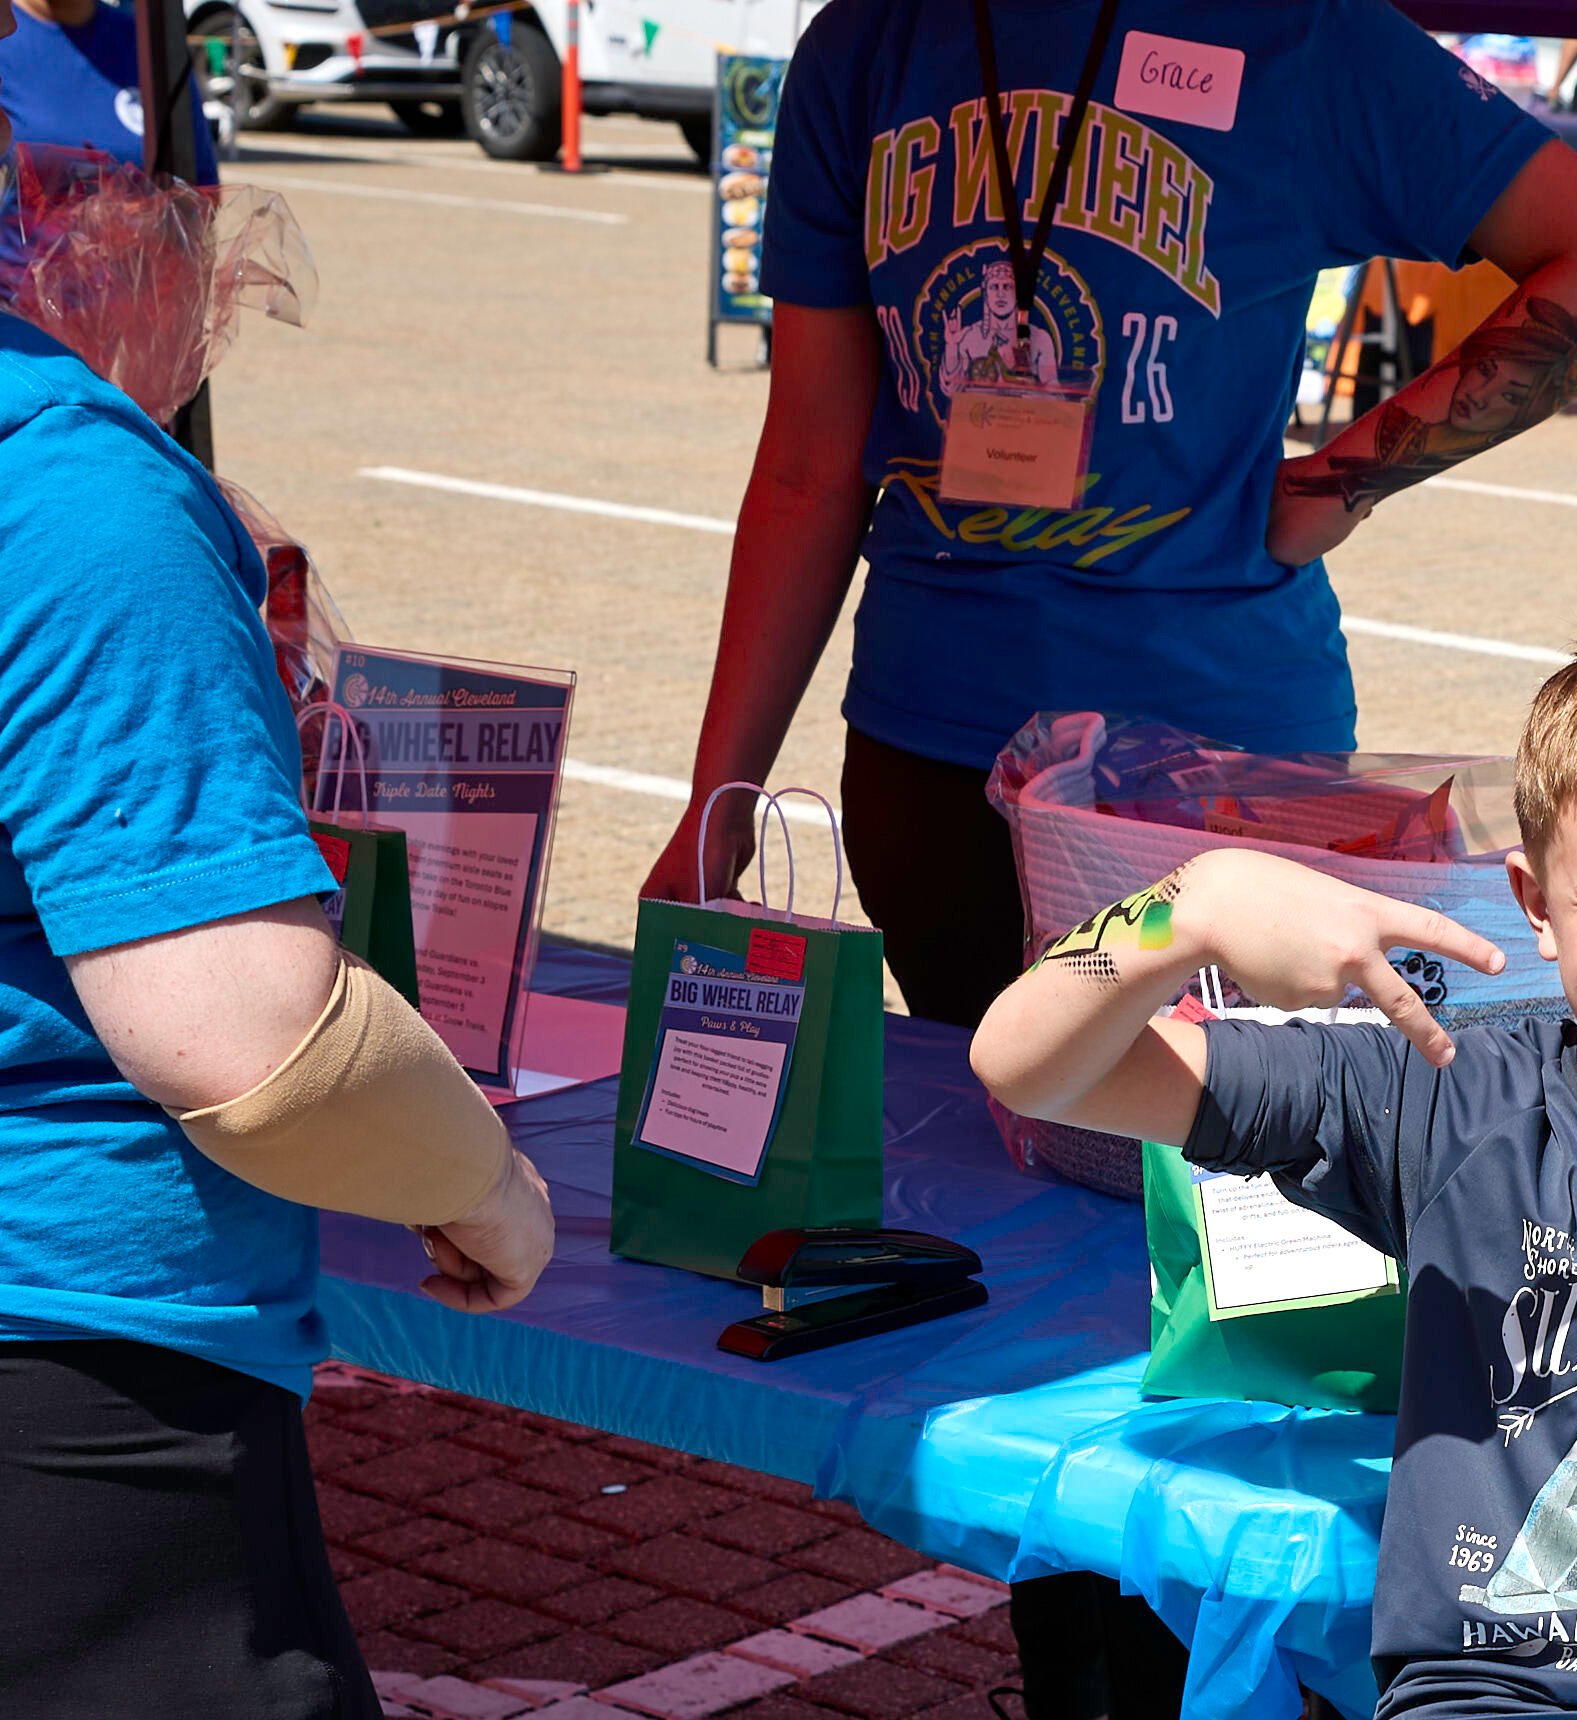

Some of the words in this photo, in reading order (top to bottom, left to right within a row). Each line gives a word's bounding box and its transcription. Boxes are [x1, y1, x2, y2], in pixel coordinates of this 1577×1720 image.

[1140, 51, 1213, 93] Grace
[864, 115, 941, 272] IG
[949, 89, 1221, 319] WHEEL
[1121, 312, 1179, 424] 26
[986, 448, 1038, 463] Volunteer
[345, 654, 365, 668] #10
[367, 685, 397, 705] 14th
[400, 688, 449, 706] Annual
[451, 689, 517, 706] Cleveland
[328, 717, 371, 760] BIG
[379, 721, 470, 763] WHEEL
[477, 722, 562, 763] RELAY
[373, 782, 410, 802] Triple
[415, 782, 448, 798] Date
[452, 783, 497, 804] Nights
[697, 963, 715, 976] 14th
[671, 979, 698, 1004] BIG
[702, 984, 752, 1012] WHEEL
[756, 991, 800, 1017] RELAY
[701, 1016, 727, 1031] Paws
[730, 1021, 737, 1031] &
[739, 1021, 761, 1038] Play
[1521, 1218, 1576, 1252] NORTH
[1455, 1524, 1498, 1549] Since
[1448, 1544, 1495, 1573] 1969
